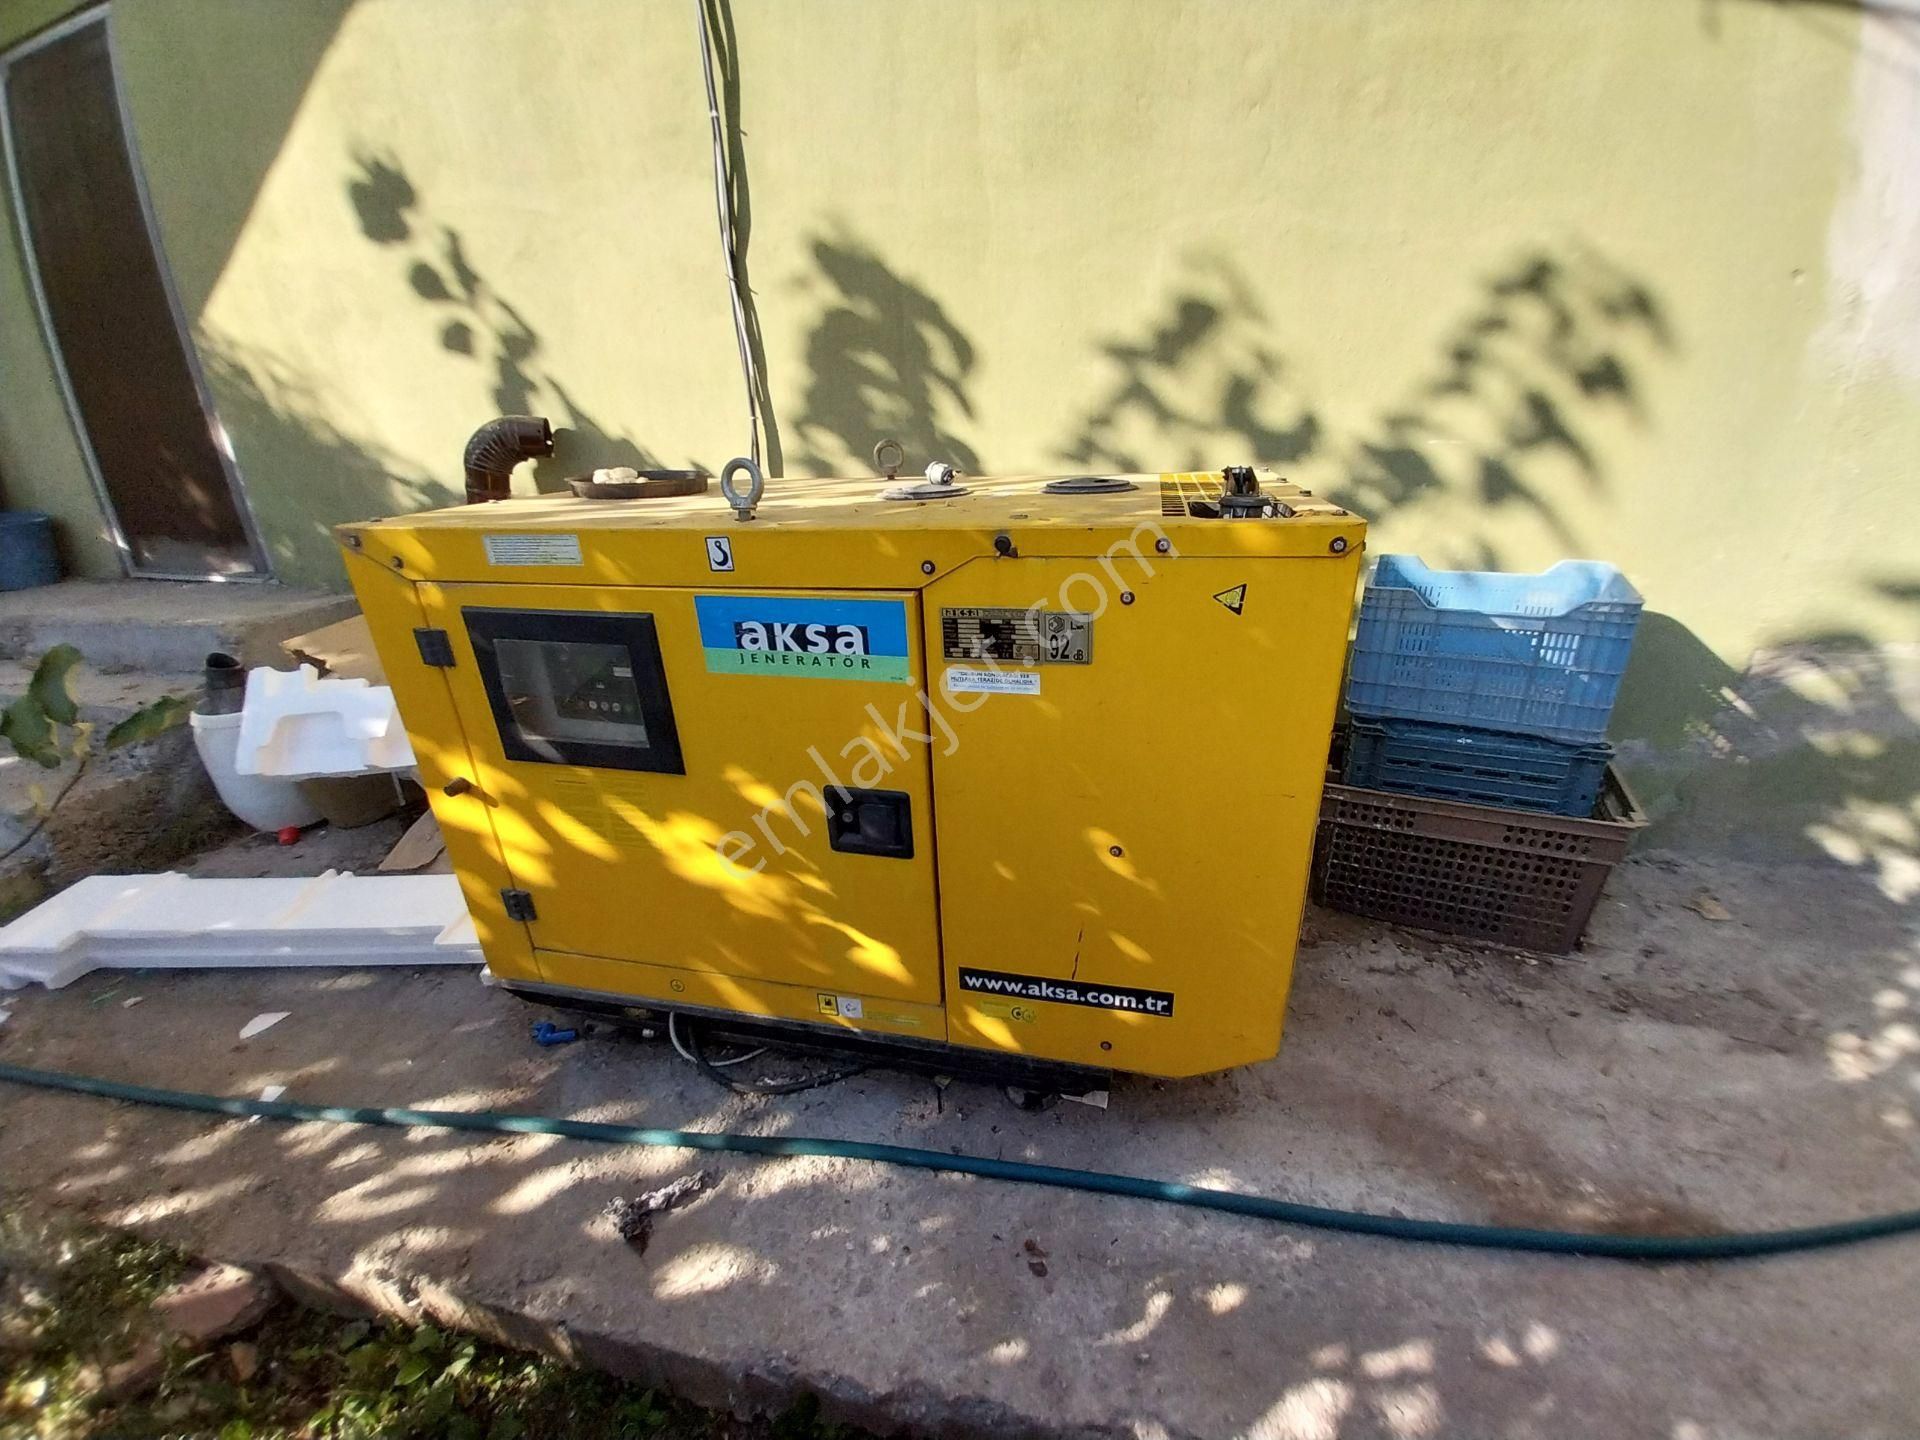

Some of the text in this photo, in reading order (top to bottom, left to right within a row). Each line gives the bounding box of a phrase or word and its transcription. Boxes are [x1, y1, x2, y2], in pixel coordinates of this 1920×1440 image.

[740, 620, 866, 655] aksa
[1049, 633, 1070, 660] 92
[738, 653, 872, 669] JENERATÖR
[964, 974, 1168, 1013] www.aksa.com.tr
